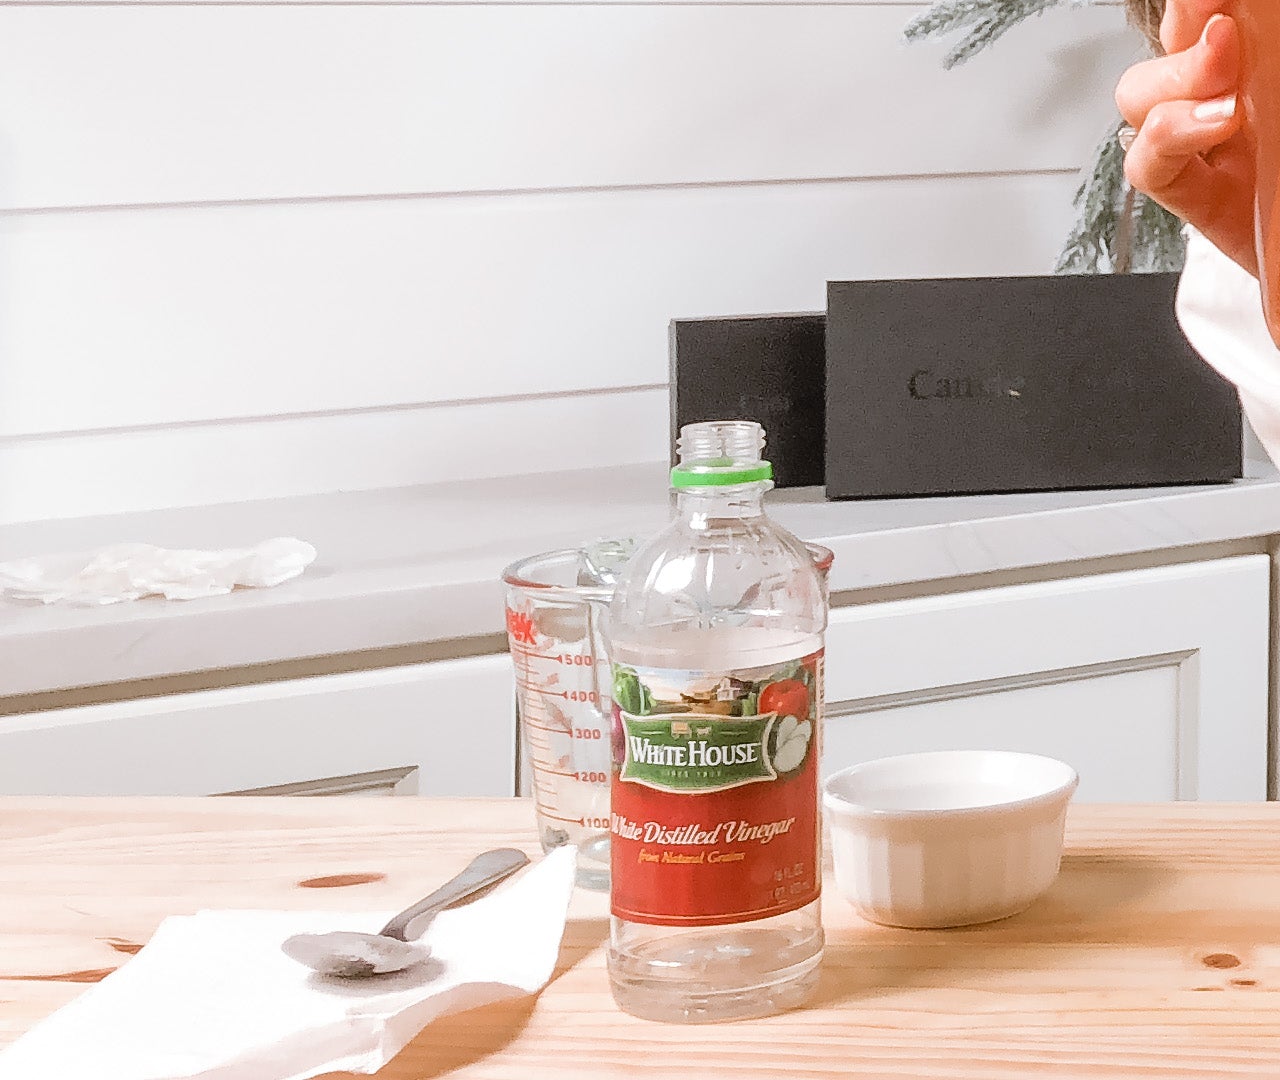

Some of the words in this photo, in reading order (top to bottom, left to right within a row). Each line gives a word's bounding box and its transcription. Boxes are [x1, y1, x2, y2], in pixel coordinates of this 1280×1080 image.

[565, 654, 593, 667] 500
[570, 691, 600, 703] 400
[575, 728, 601, 740] 300
[629, 735, 687, 767] WHITE
[687, 740, 759, 767] HOUSE
[581, 772, 607, 783] 200
[584, 818, 610, 829] 100
[643, 821, 723, 846] Distilled
[722, 817, 796, 845] Vinegar
